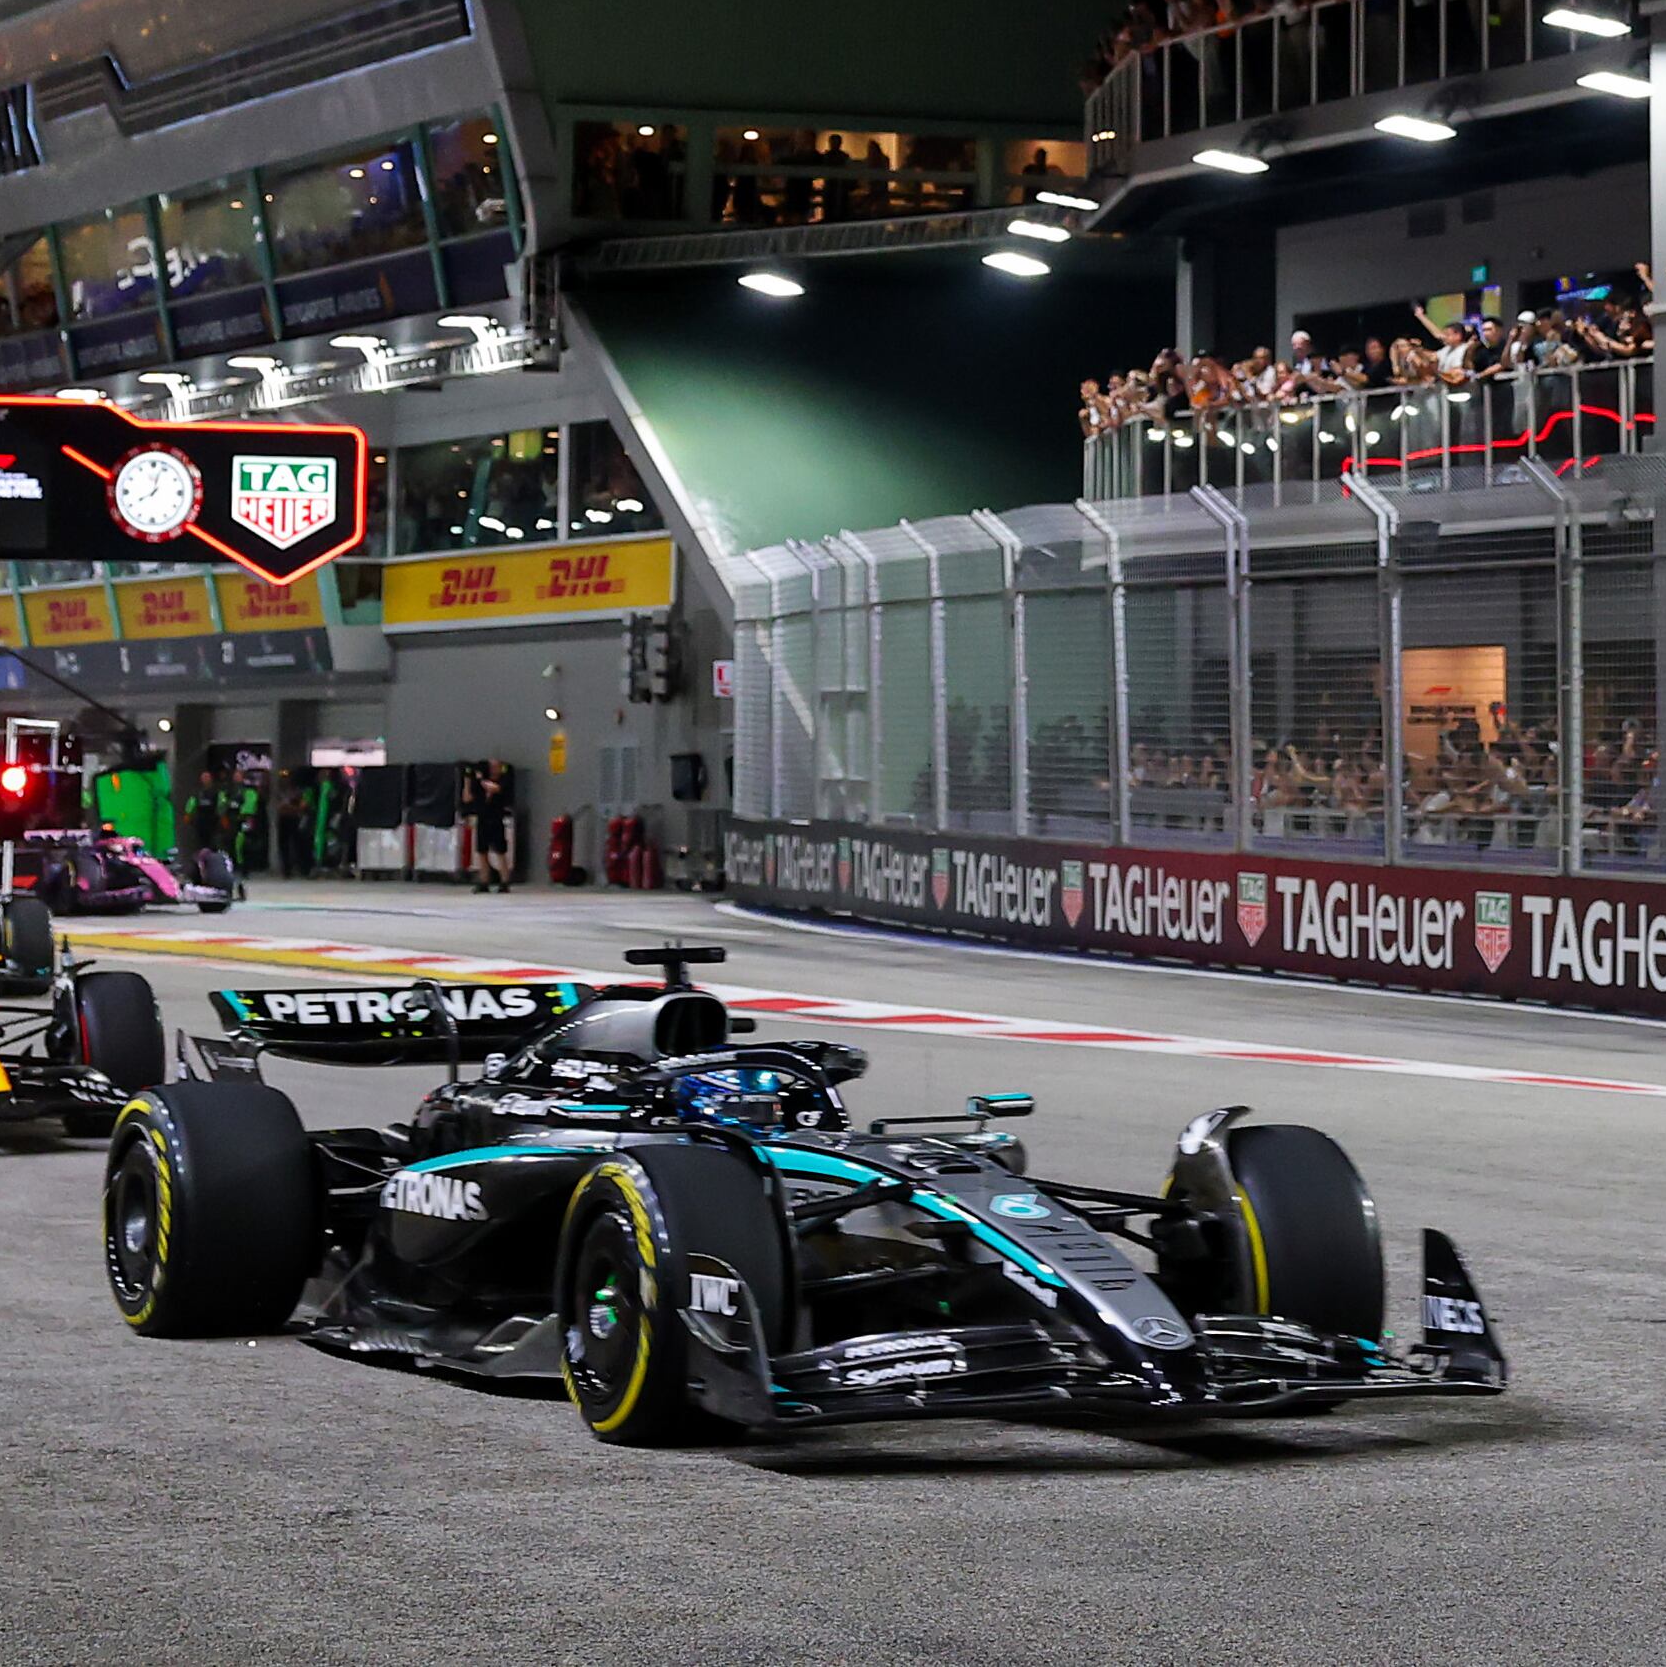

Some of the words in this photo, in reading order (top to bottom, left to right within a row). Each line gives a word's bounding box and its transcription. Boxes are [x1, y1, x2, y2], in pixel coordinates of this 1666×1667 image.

[242, 464, 327, 493] TAG
[239, 498, 328, 540] HEUER
[439, 566, 499, 607] DHL
[546, 555, 613, 597] DHL
[1088, 862, 1231, 945] TAGHeuer
[1275, 876, 1465, 970] TAGHeuer
[688, 1273, 740, 1316] IWC
